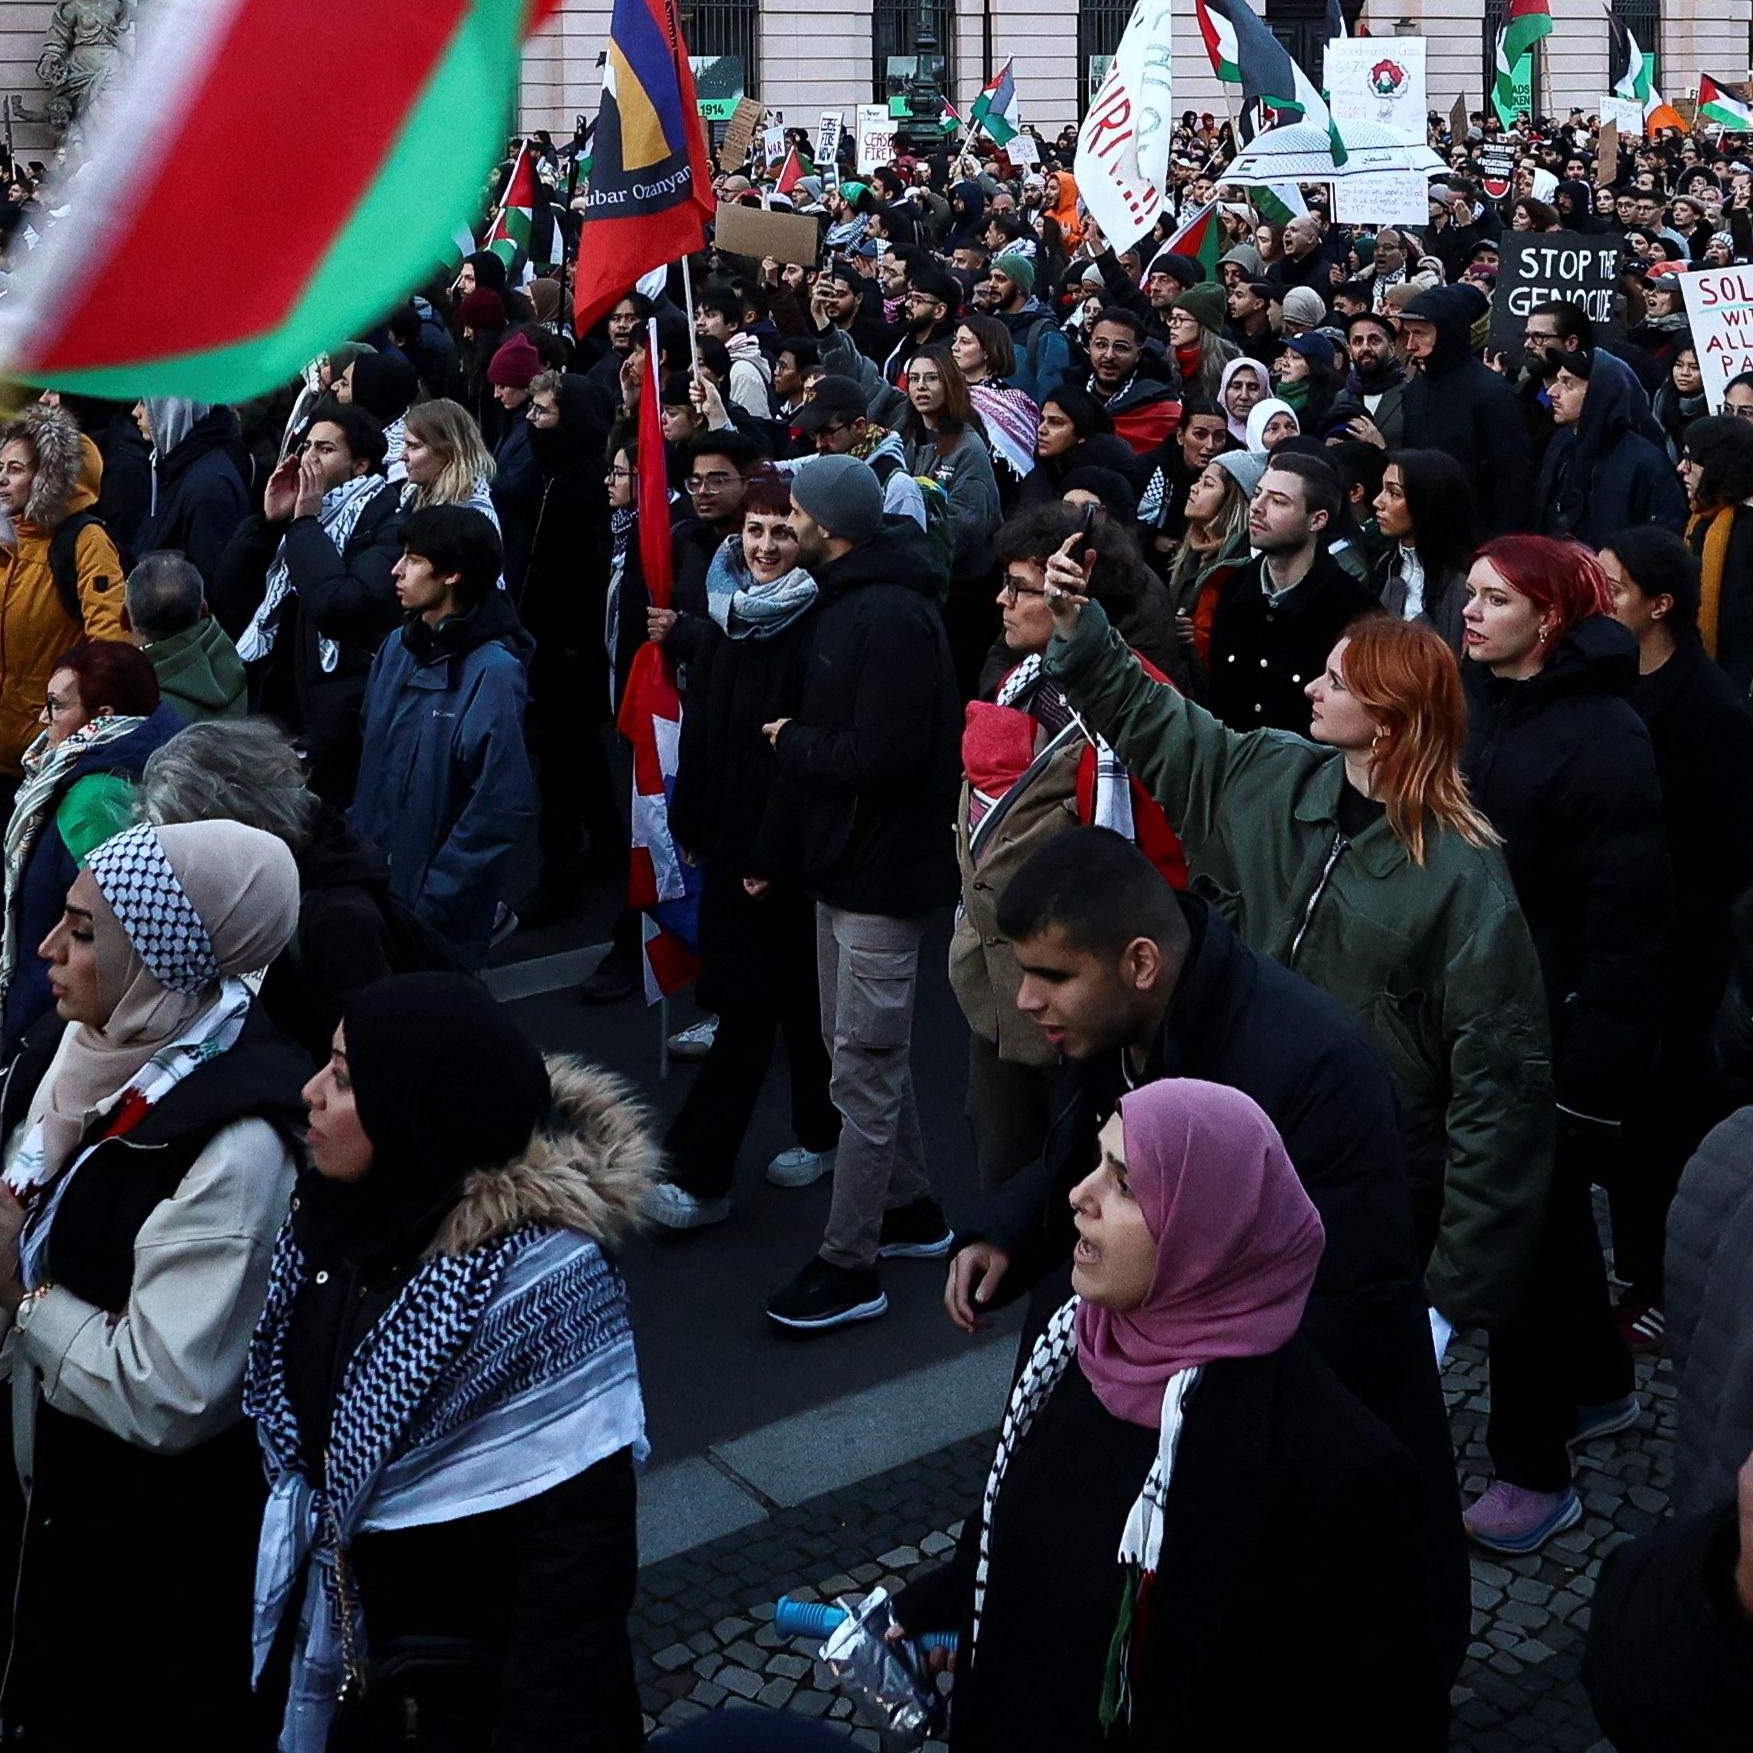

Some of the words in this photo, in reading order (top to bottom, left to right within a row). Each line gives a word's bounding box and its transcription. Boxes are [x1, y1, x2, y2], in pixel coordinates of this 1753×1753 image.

[700, 104, 725, 116] 1914
[1518, 248, 1592, 282] STOP
[1598, 250, 1618, 280] THE
[1706, 329, 1753, 353] ALL
